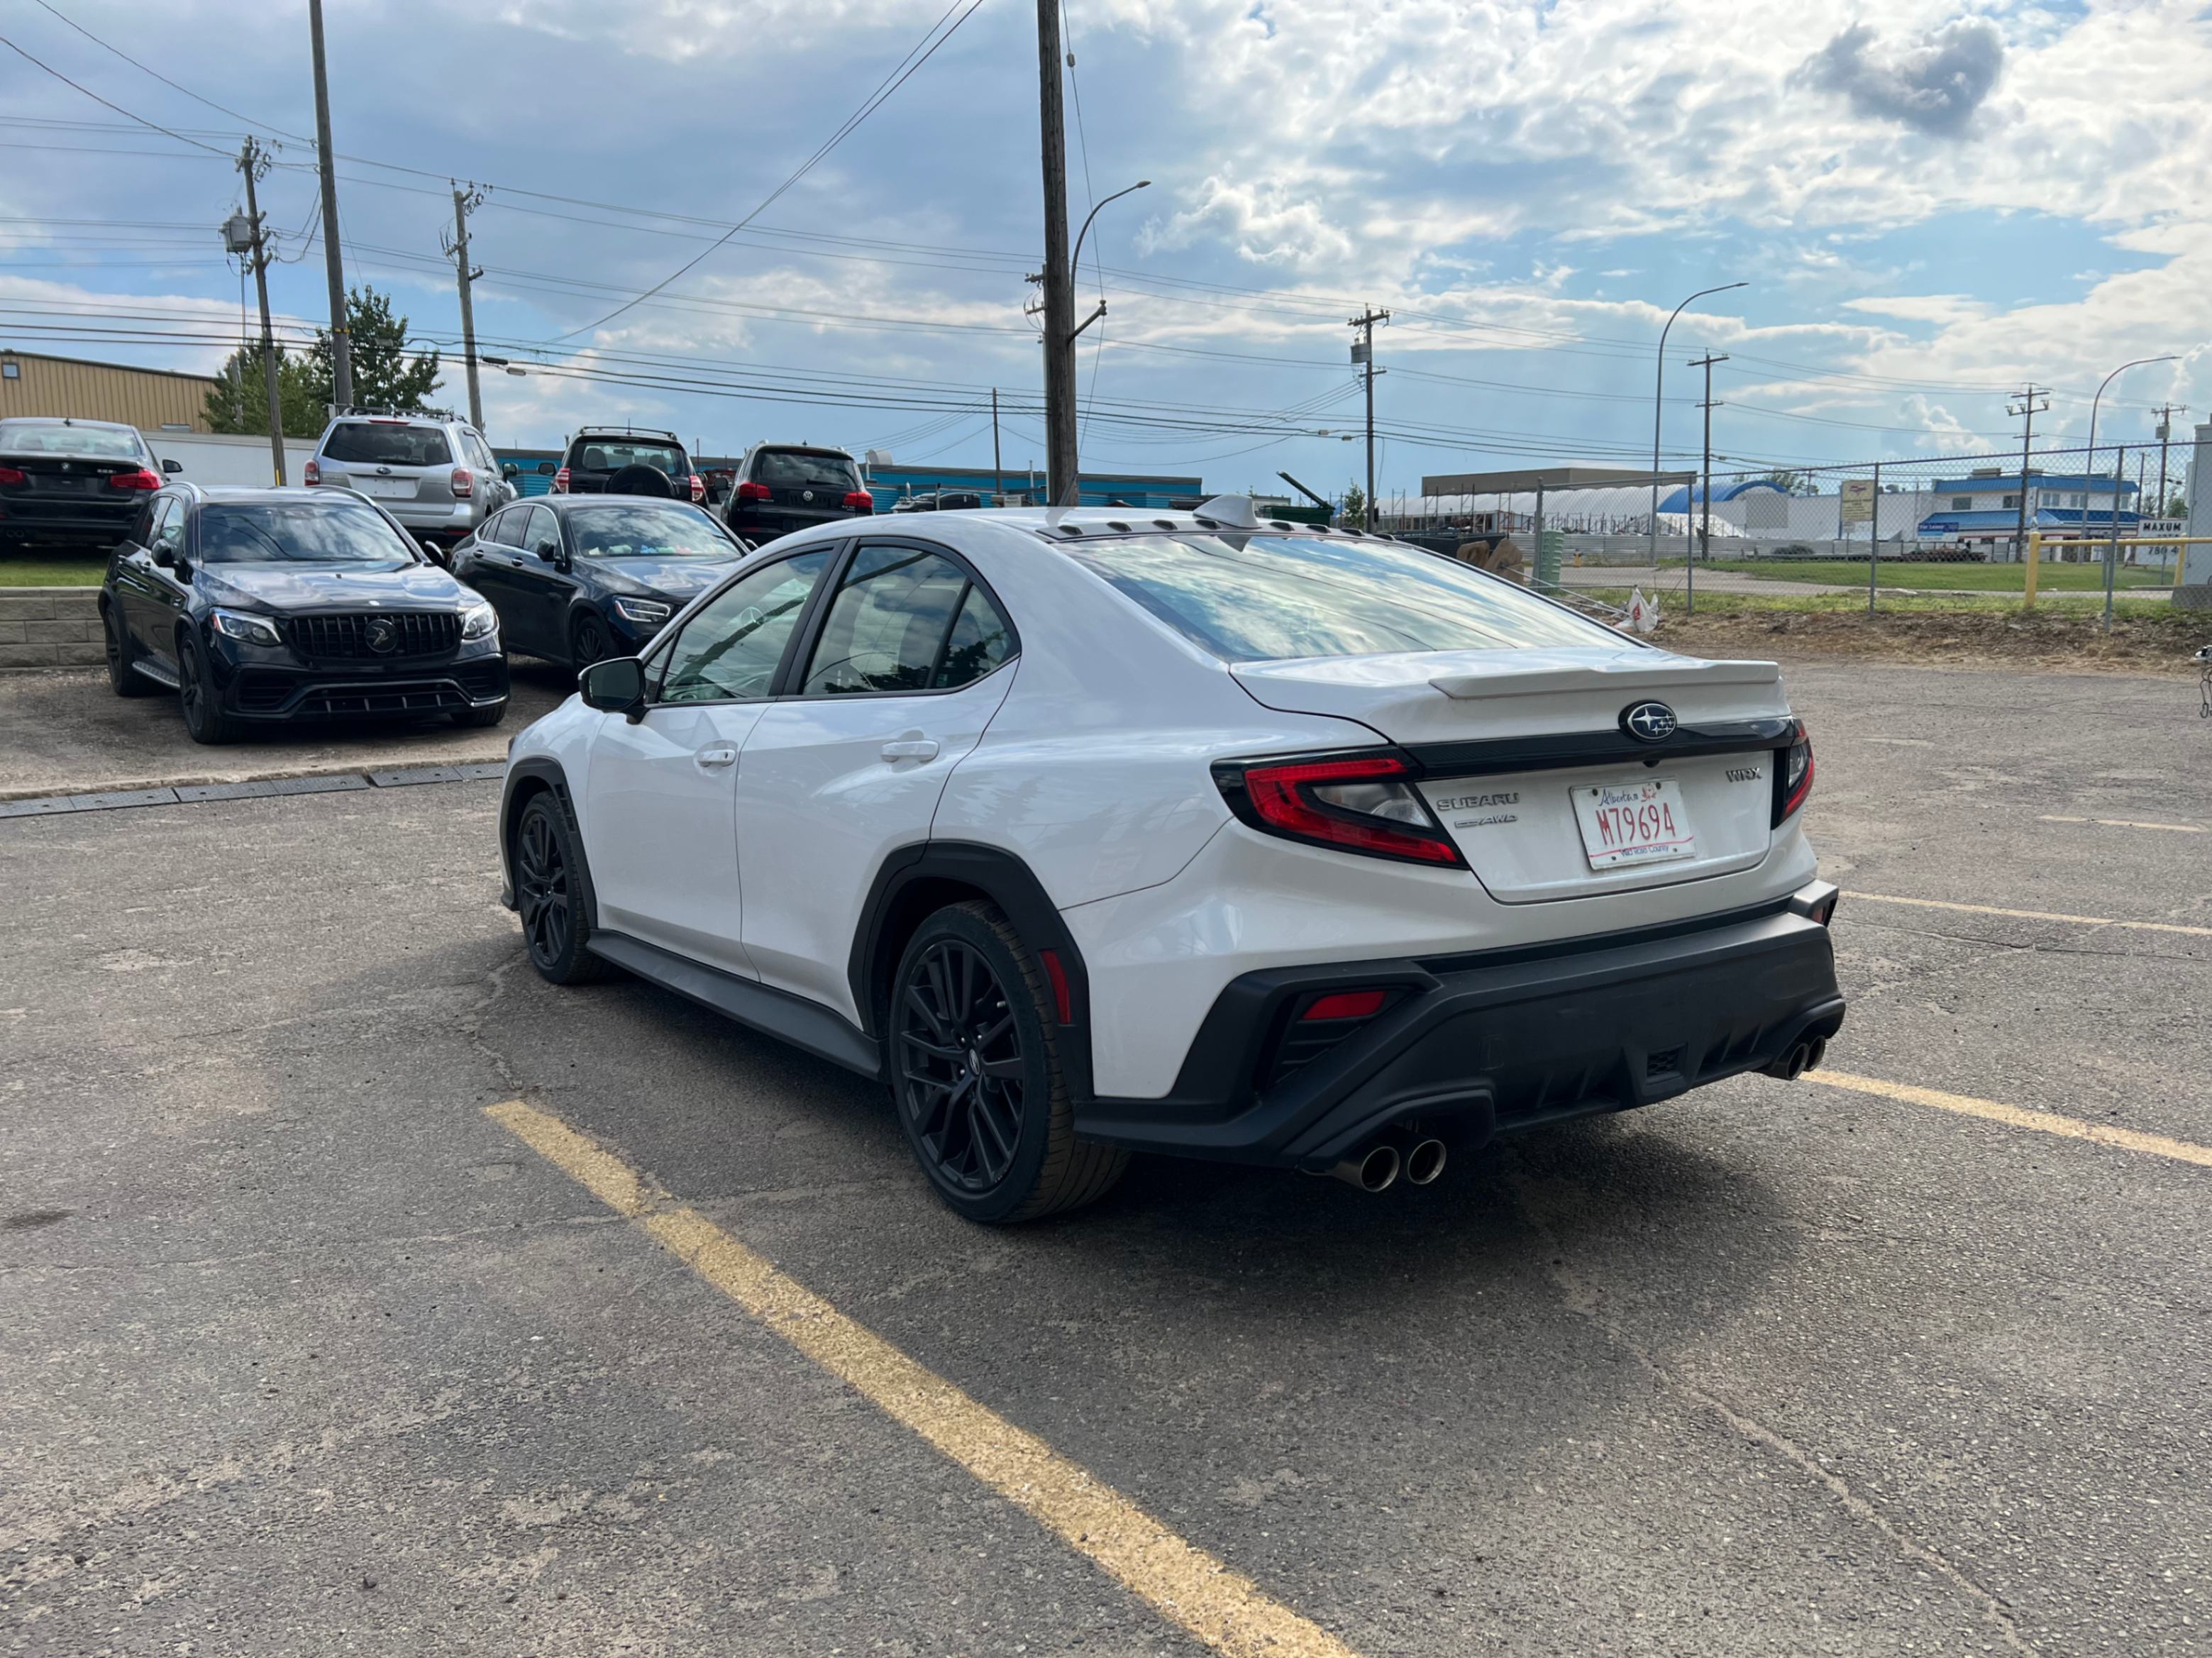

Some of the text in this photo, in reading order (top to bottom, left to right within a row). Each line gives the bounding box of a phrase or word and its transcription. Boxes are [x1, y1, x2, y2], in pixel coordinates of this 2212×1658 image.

[2143, 522, 2181, 531] MAXUM
[2148, 546, 2167, 555] 780
[1725, 767, 1762, 783] WRX
[1436, 792, 1520, 811] SUBARU
[1478, 814, 1517, 826] AWD
[1596, 802, 1676, 845] M79694
